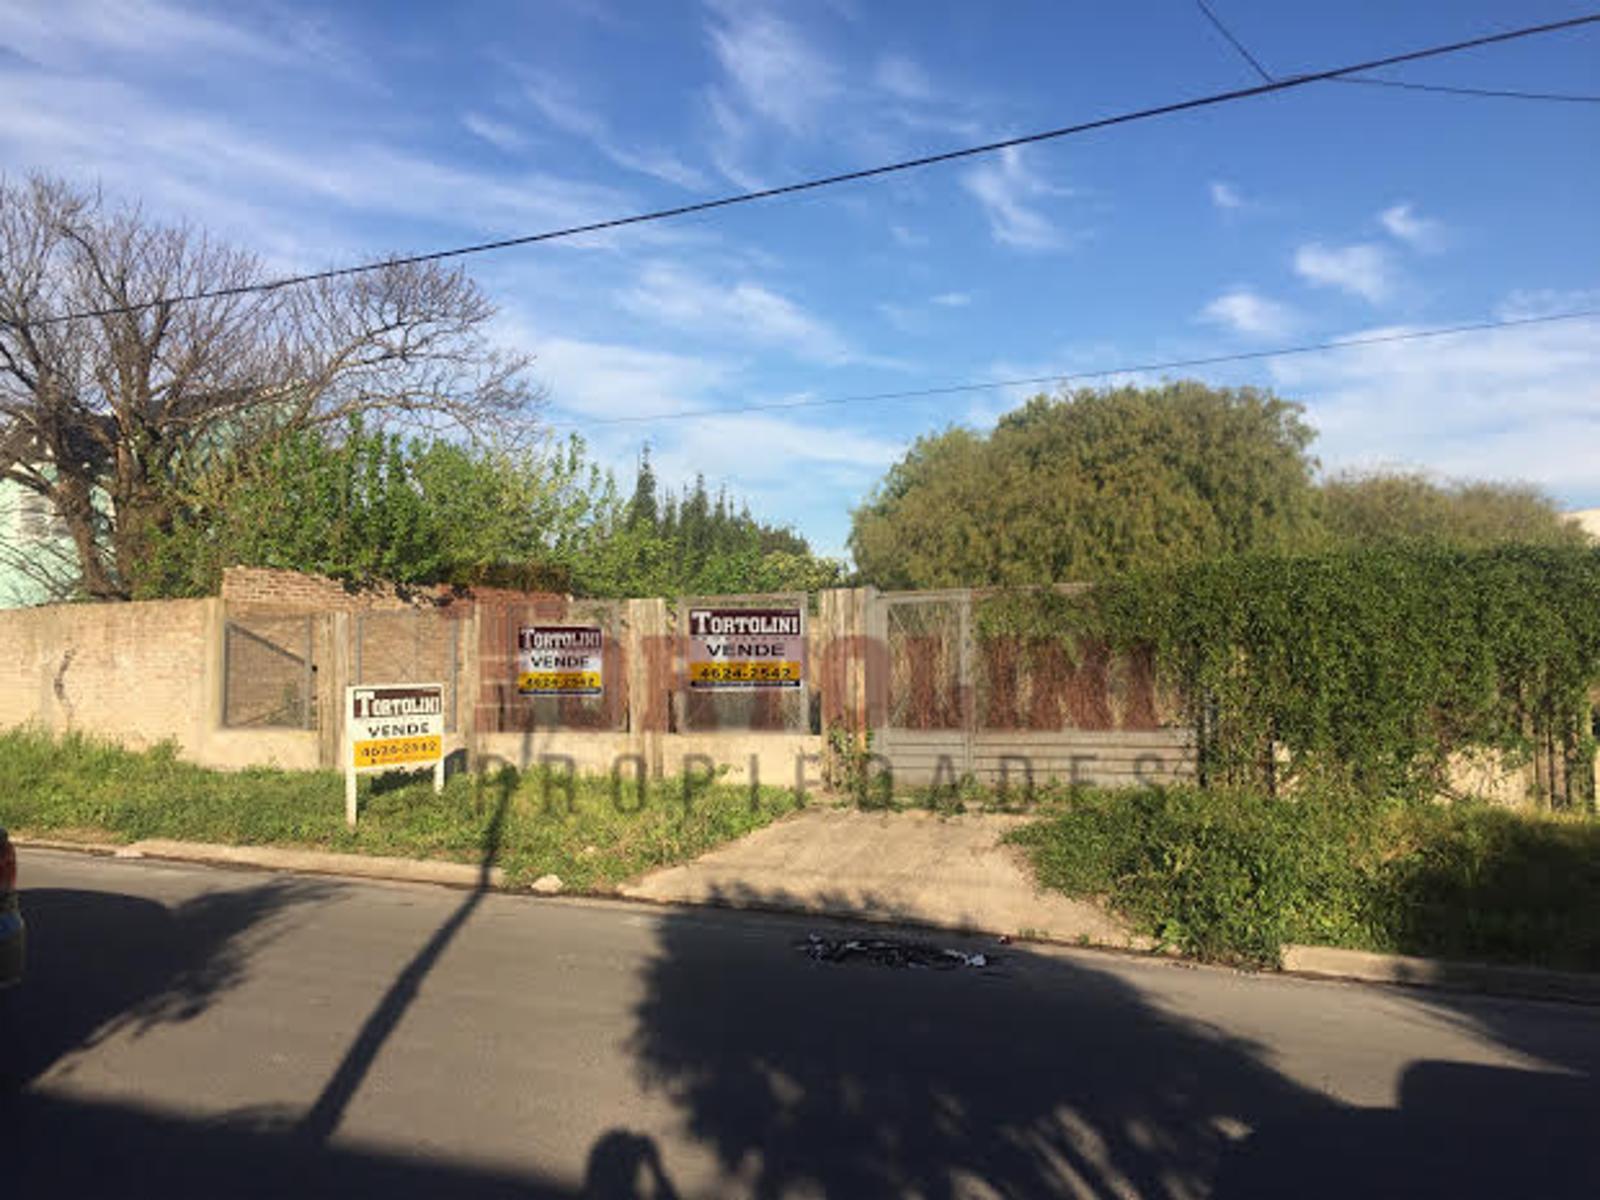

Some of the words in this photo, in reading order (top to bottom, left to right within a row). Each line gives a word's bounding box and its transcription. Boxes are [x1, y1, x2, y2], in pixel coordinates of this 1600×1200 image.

[691, 611, 799, 634] TORTOLINI
[520, 628, 601, 648] TORTOLINI
[706, 643, 785, 656] VENDE
[531, 655, 589, 669] VENDE
[701, 667, 791, 680] 4624-2542
[355, 691, 440, 717] TORTOLINI
[367, 722, 429, 737] VENDE
